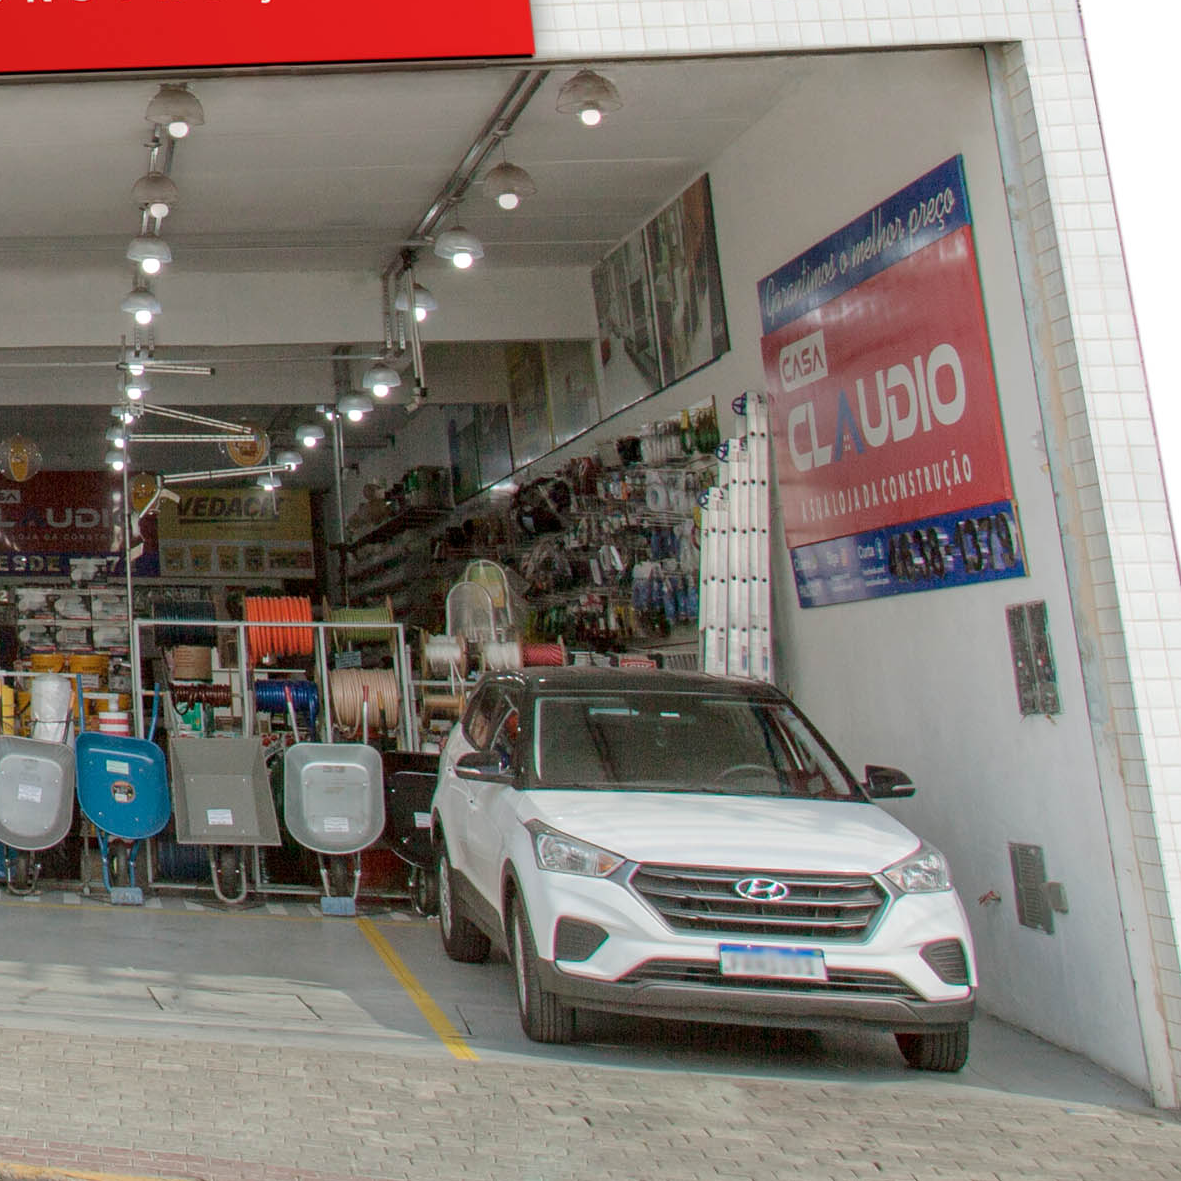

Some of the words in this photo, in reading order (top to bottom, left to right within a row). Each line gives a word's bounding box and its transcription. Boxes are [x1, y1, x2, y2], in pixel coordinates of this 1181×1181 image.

[765, 253, 837, 325] Garantimos
[838, 250, 849, 275] o
[852, 206, 905, 268] melhor
[907, 187, 955, 241] preço
[781, 342, 825, 383] CASA
[788, 343, 966, 472] CLAUDIO
[833, 486, 861, 516] LOJA
[862, 481, 880, 508] DA
[881, 450, 973, 504] CONSTRUÇÃO
